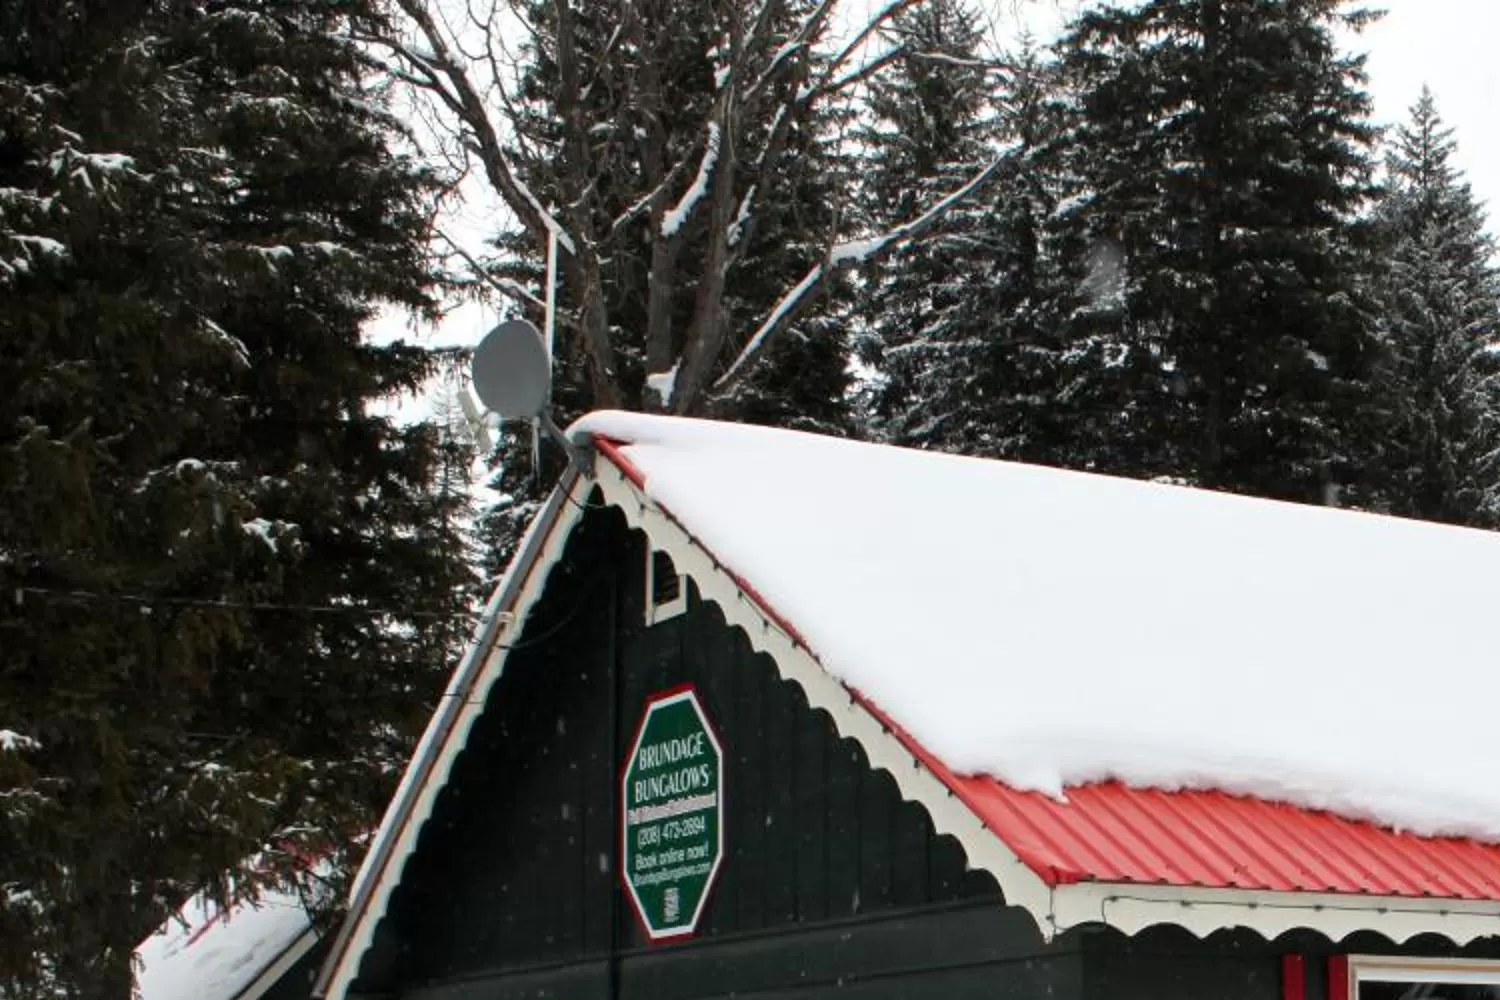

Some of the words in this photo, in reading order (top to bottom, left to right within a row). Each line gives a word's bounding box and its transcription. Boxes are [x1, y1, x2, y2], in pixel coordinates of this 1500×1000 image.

[639, 731, 704, 771] BRUNDAGE
[635, 763, 709, 803] BUNGALOWS
[635, 853, 657, 871] Book
[659, 848, 685, 866] online
[687, 840, 709, 859] now!
